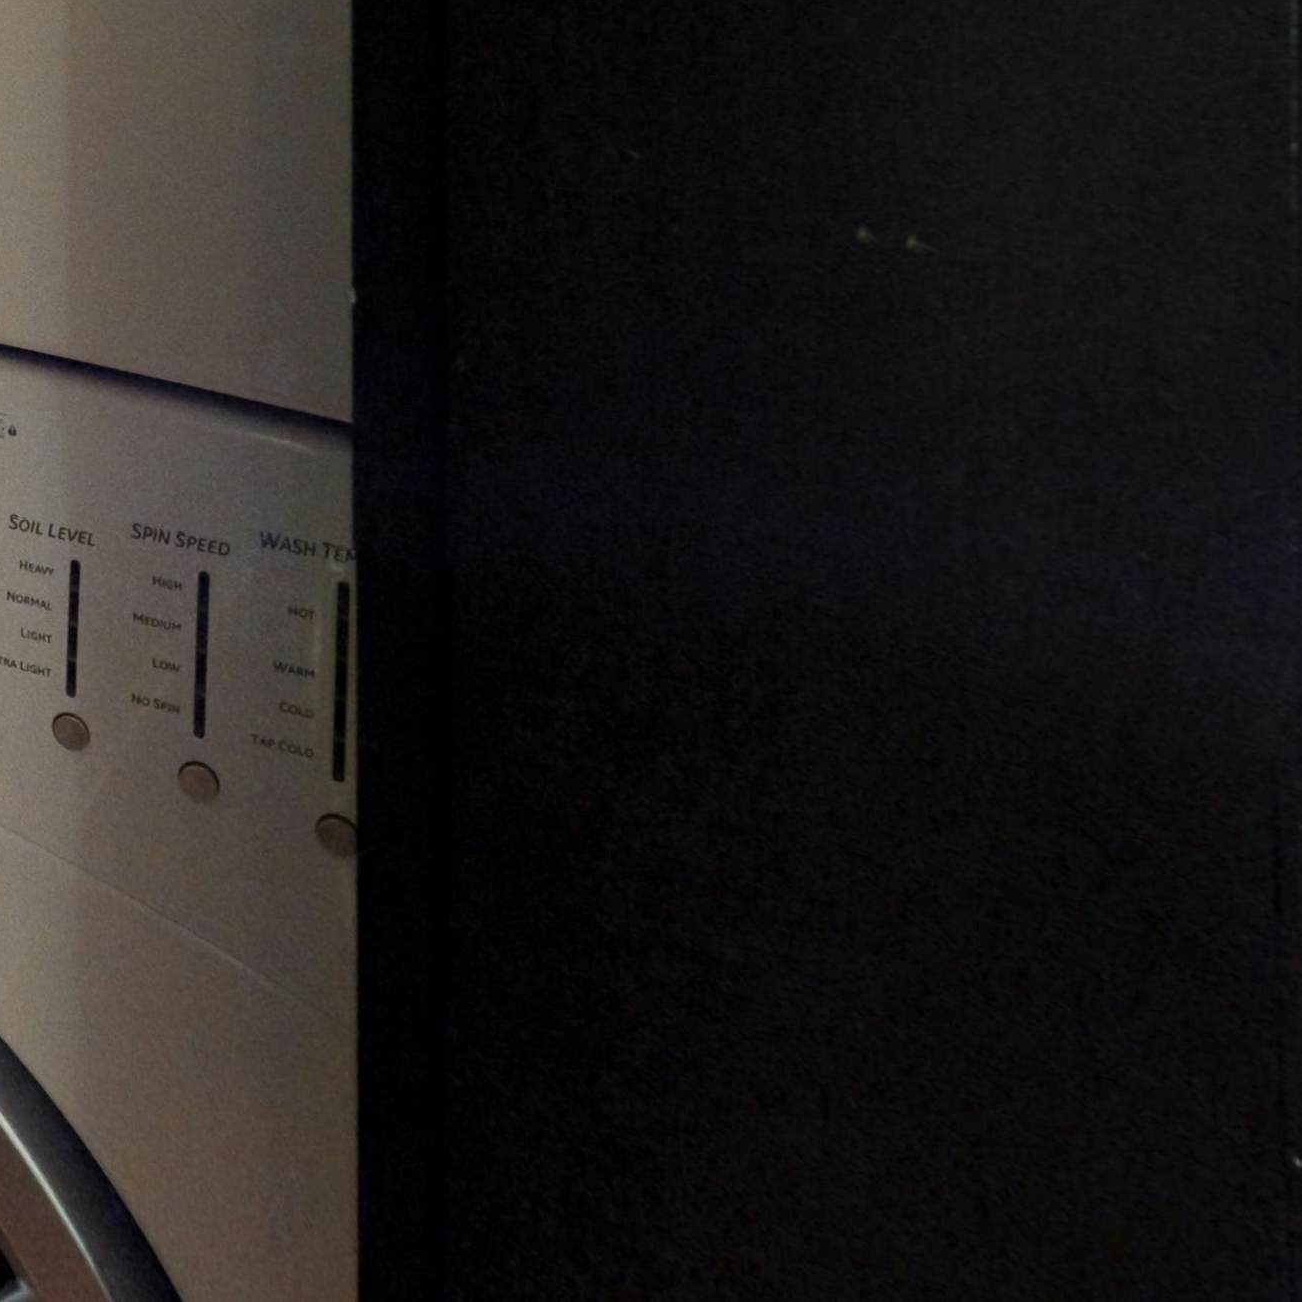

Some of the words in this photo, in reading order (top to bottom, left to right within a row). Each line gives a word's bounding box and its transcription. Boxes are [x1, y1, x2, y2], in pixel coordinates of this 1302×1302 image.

[8, 514, 43, 535] SOIL
[48, 523, 95, 546] LEVEL
[131, 522, 170, 545] SPIN
[175, 531, 231, 557] SPEED
[259, 529, 316, 557] WASH
[19, 560, 55, 576] HEAVY
[152, 575, 182, 592] HIGH
[6, 591, 52, 611] NORMAL
[132, 612, 182, 632] MEDIUM
[287, 604, 315, 620] HOT
[20, 628, 52, 644] LIGHT
[20, 661, 51, 678] LIGHT
[151, 657, 181, 673] LOW
[272, 659, 315, 678] WARM
[131, 693, 150, 707] NO
[153, 698, 181, 714] SPIN
[278, 699, 315, 719] COLD
[277, 739, 315, 759] COLD
